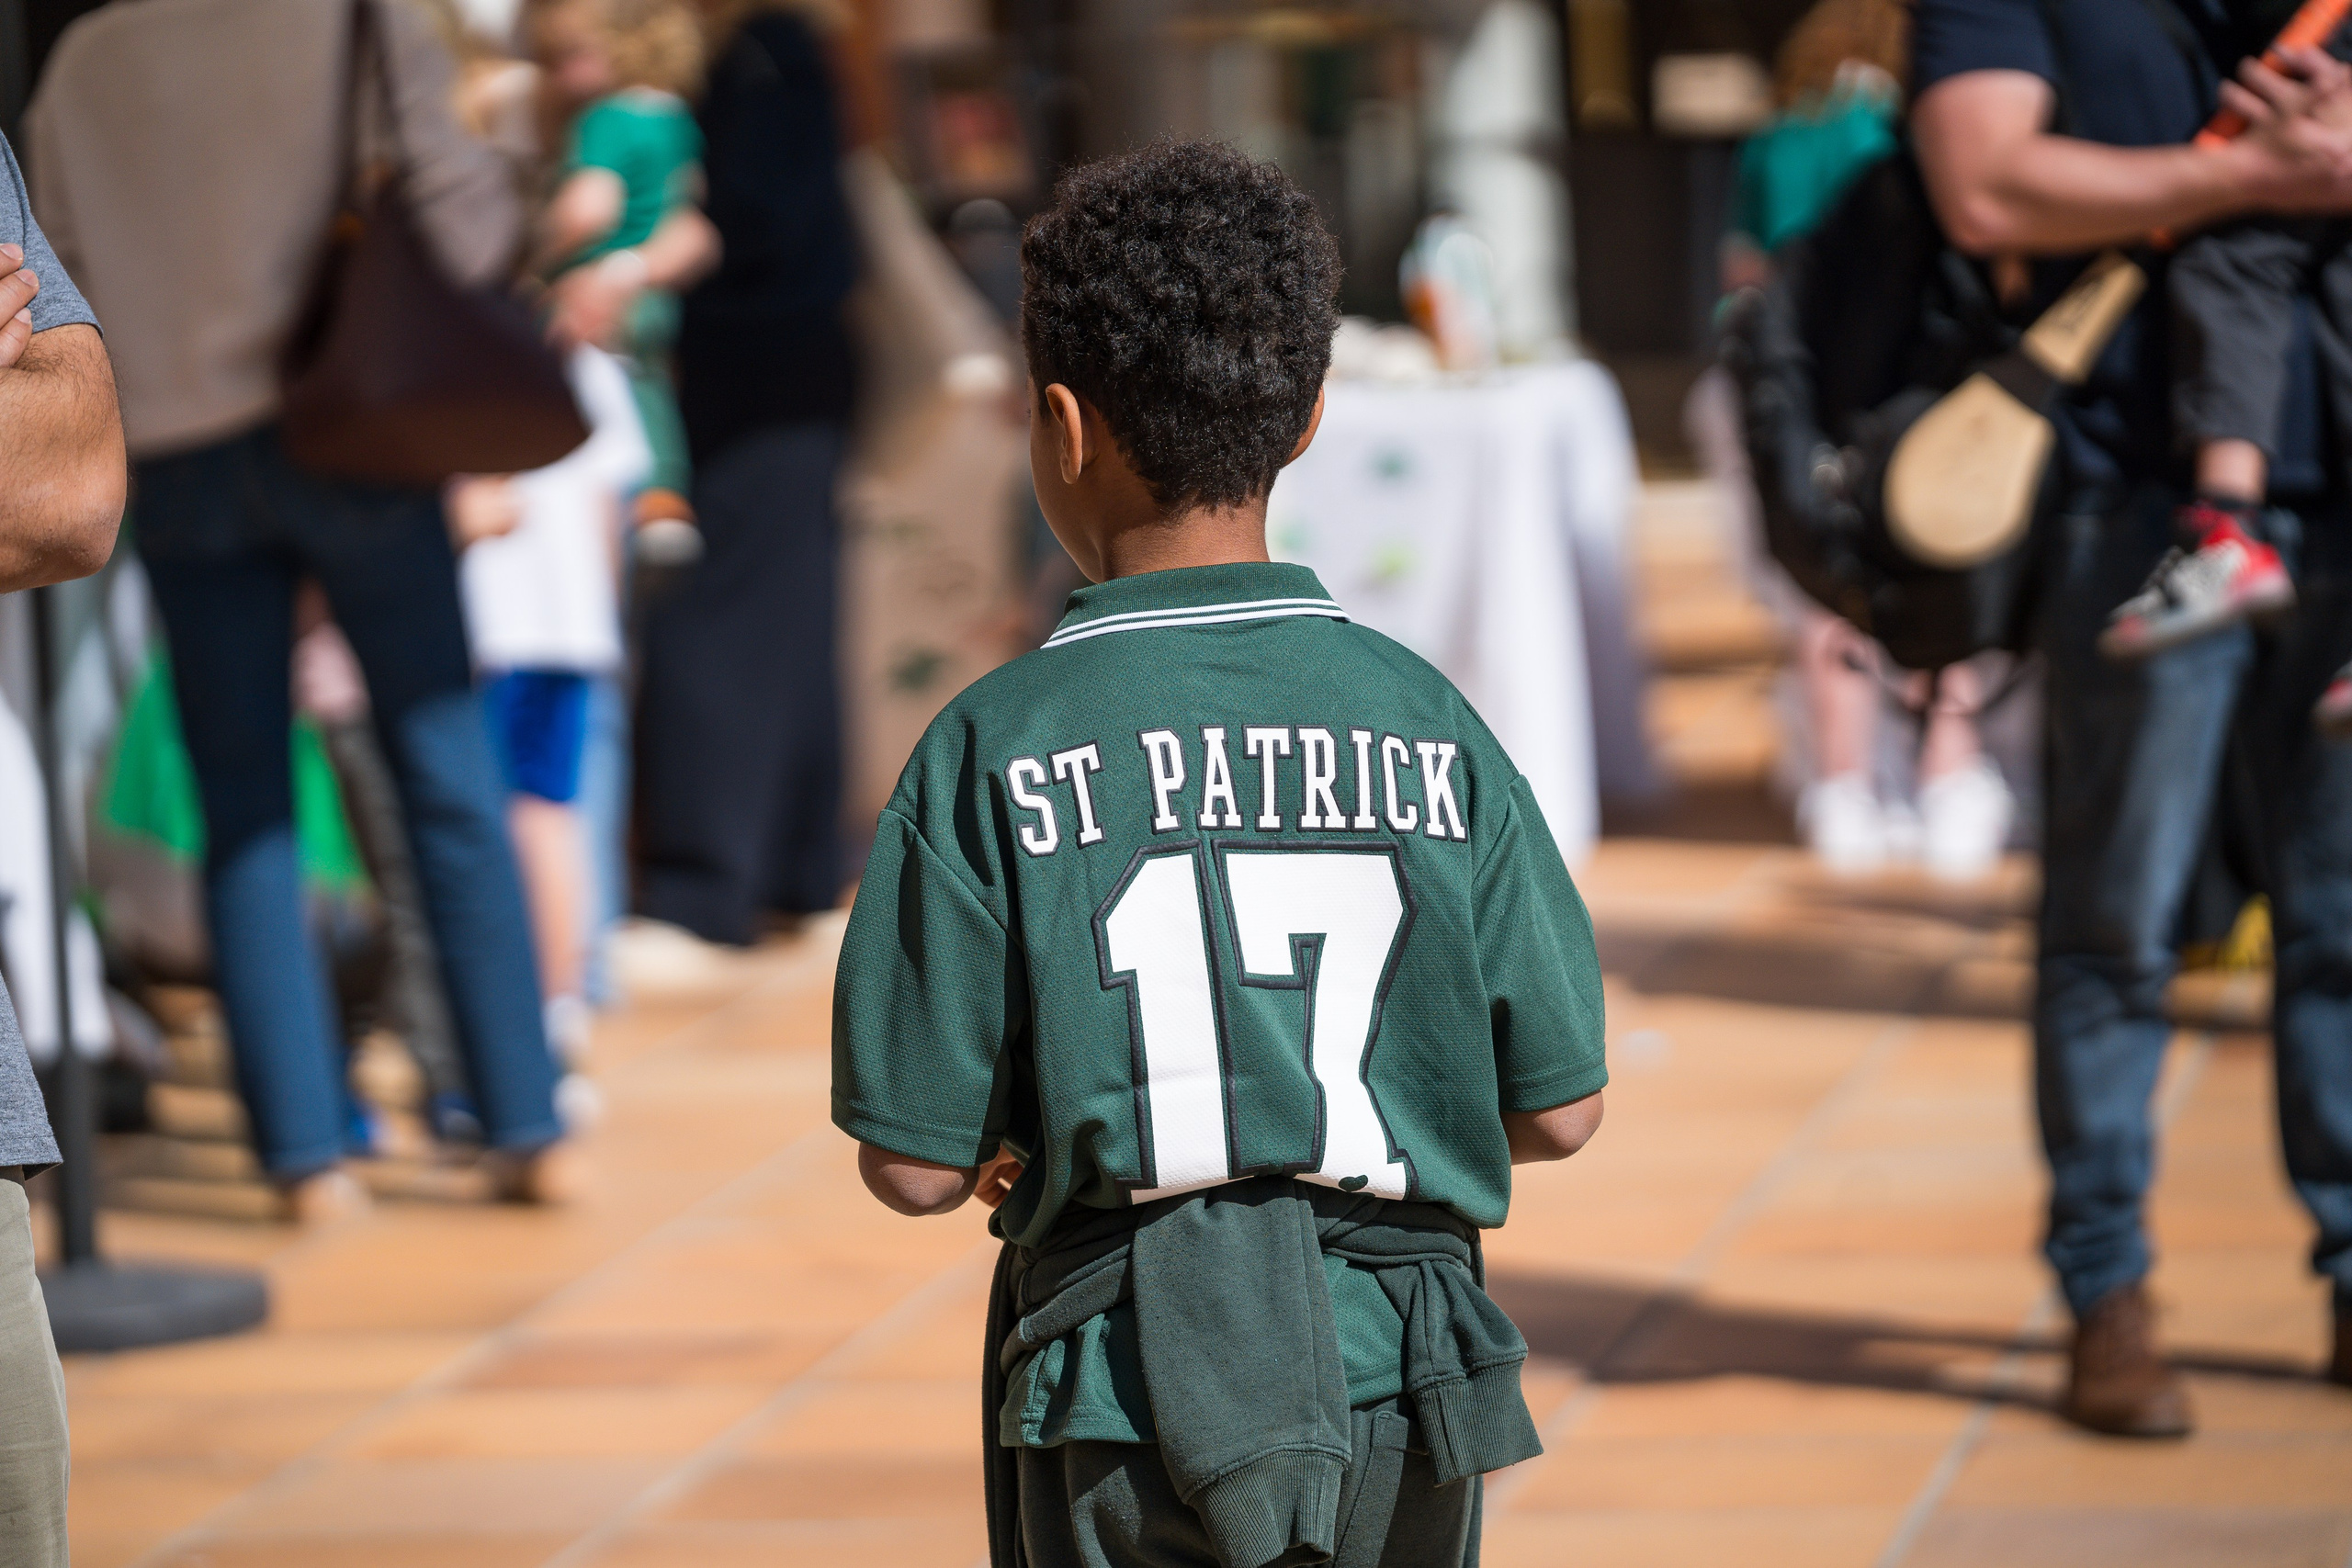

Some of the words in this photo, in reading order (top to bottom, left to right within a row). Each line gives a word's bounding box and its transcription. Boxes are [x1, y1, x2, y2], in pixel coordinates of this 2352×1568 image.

[1005, 740, 1105, 856] ST
[1138, 725, 1468, 841] PATRICK
[1091, 840, 1418, 1204] 17
